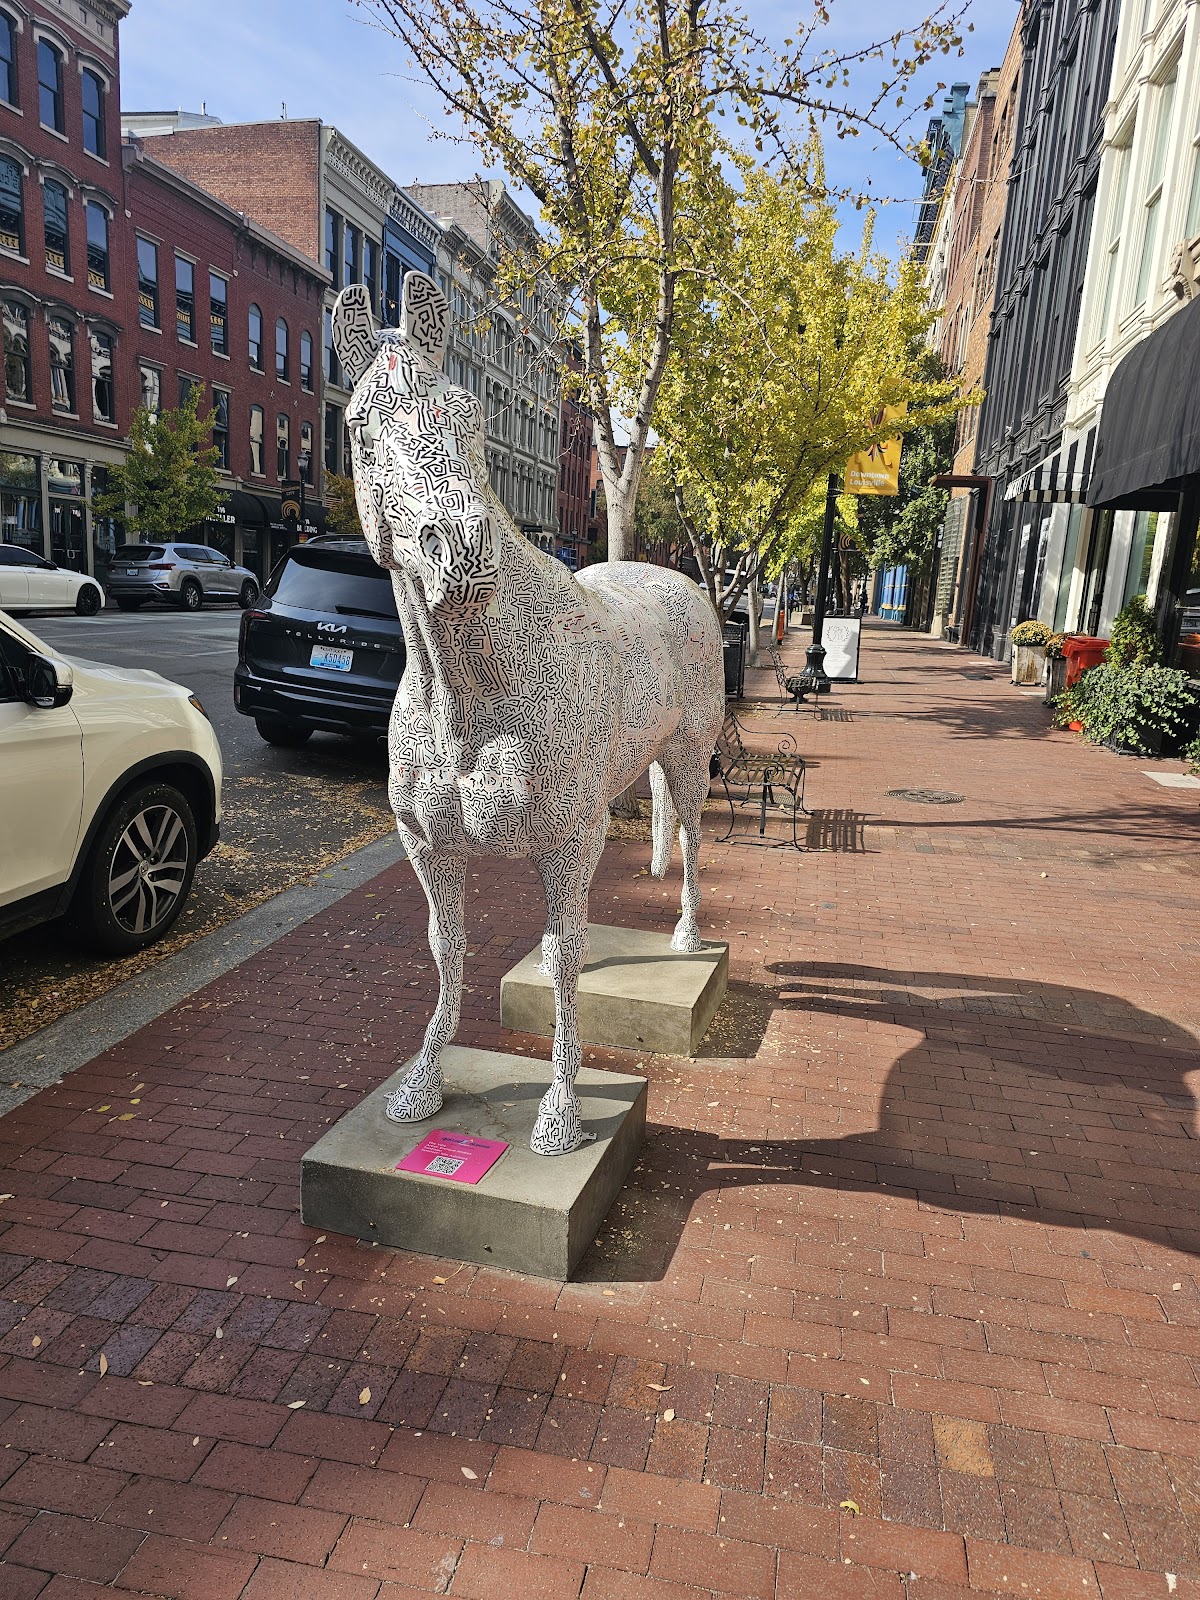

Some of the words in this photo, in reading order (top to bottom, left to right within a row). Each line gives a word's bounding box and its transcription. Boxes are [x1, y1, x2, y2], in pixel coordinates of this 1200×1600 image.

[850, 471, 889, 480] Downtown
[296, 524, 318, 534] BULDING
[285, 629, 381, 649] TELLURIDE
